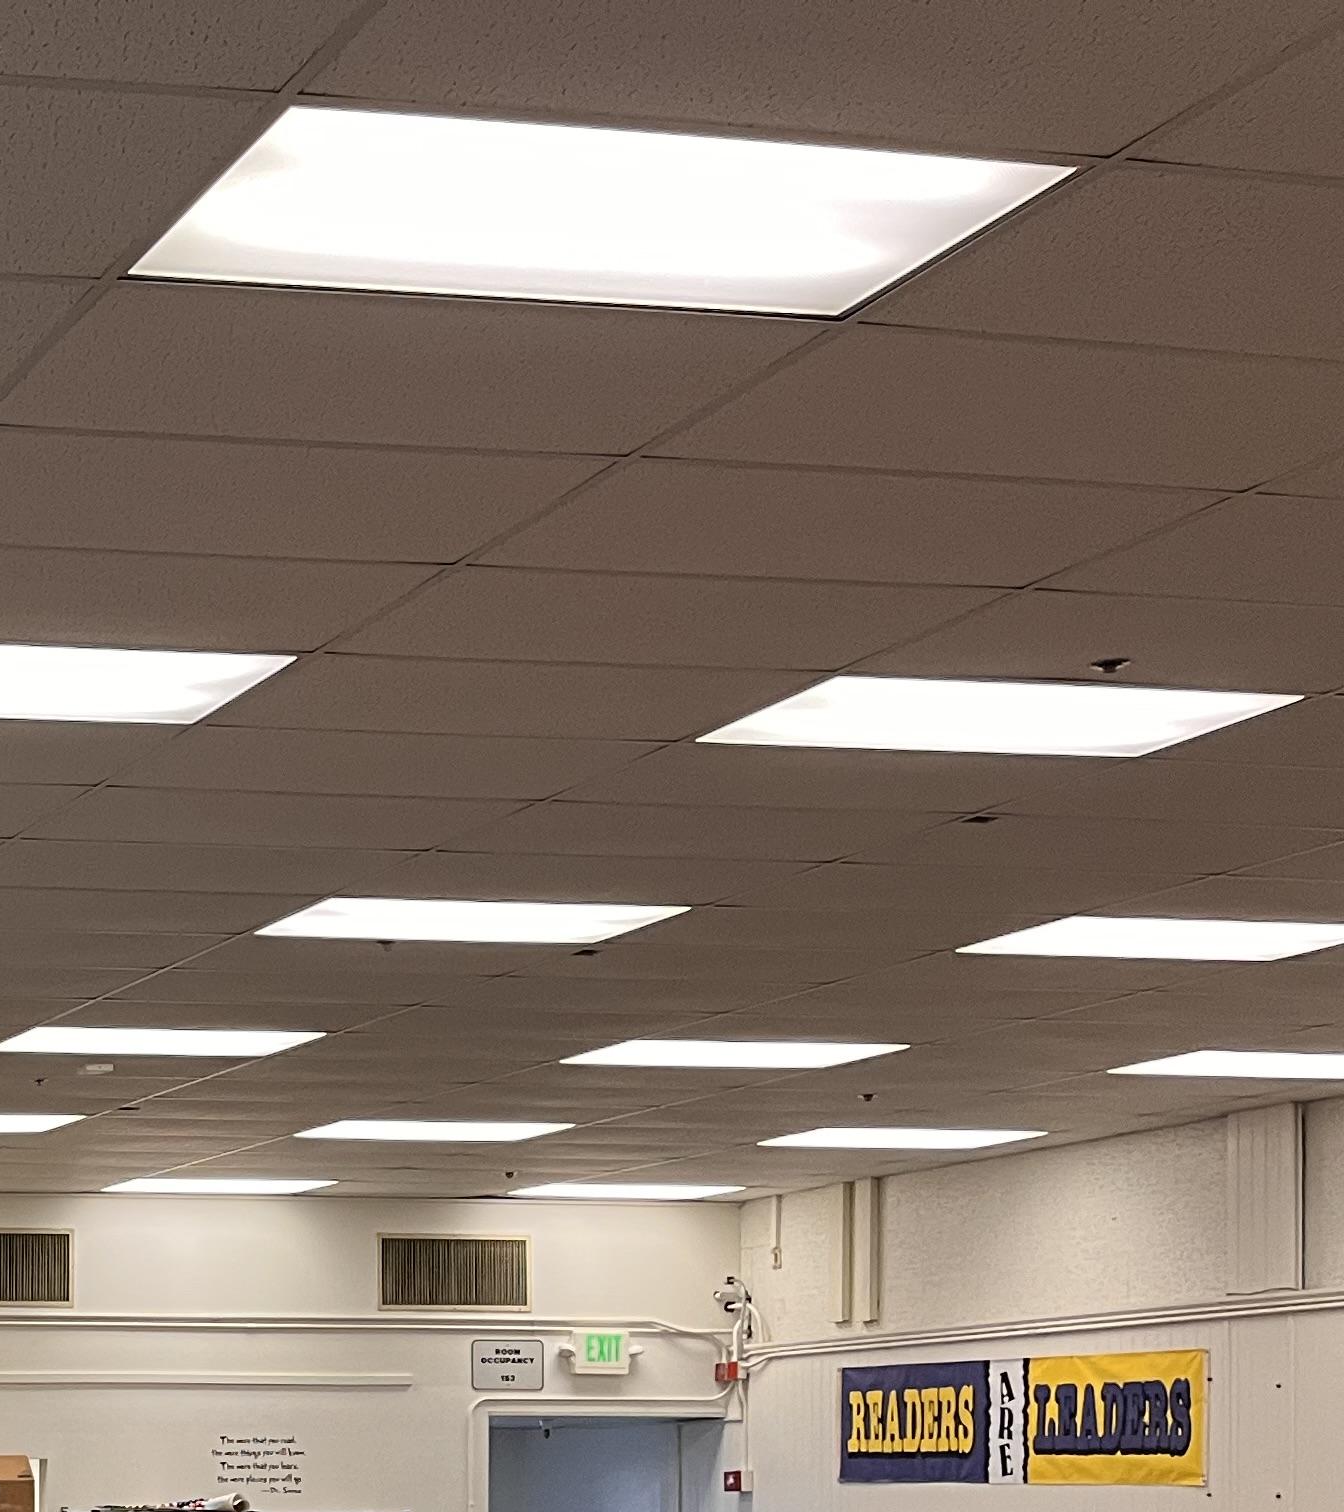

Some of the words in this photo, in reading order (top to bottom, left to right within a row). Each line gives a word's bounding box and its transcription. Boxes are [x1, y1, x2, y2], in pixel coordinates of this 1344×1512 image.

[495, 1348, 521, 1356] ROOM
[586, 1333, 624, 1363] EXIT
[847, 1385, 975, 1457] READERS
[998, 1371, 1015, 1477] ARE
[1033, 1377, 1192, 1457] LEADERS
